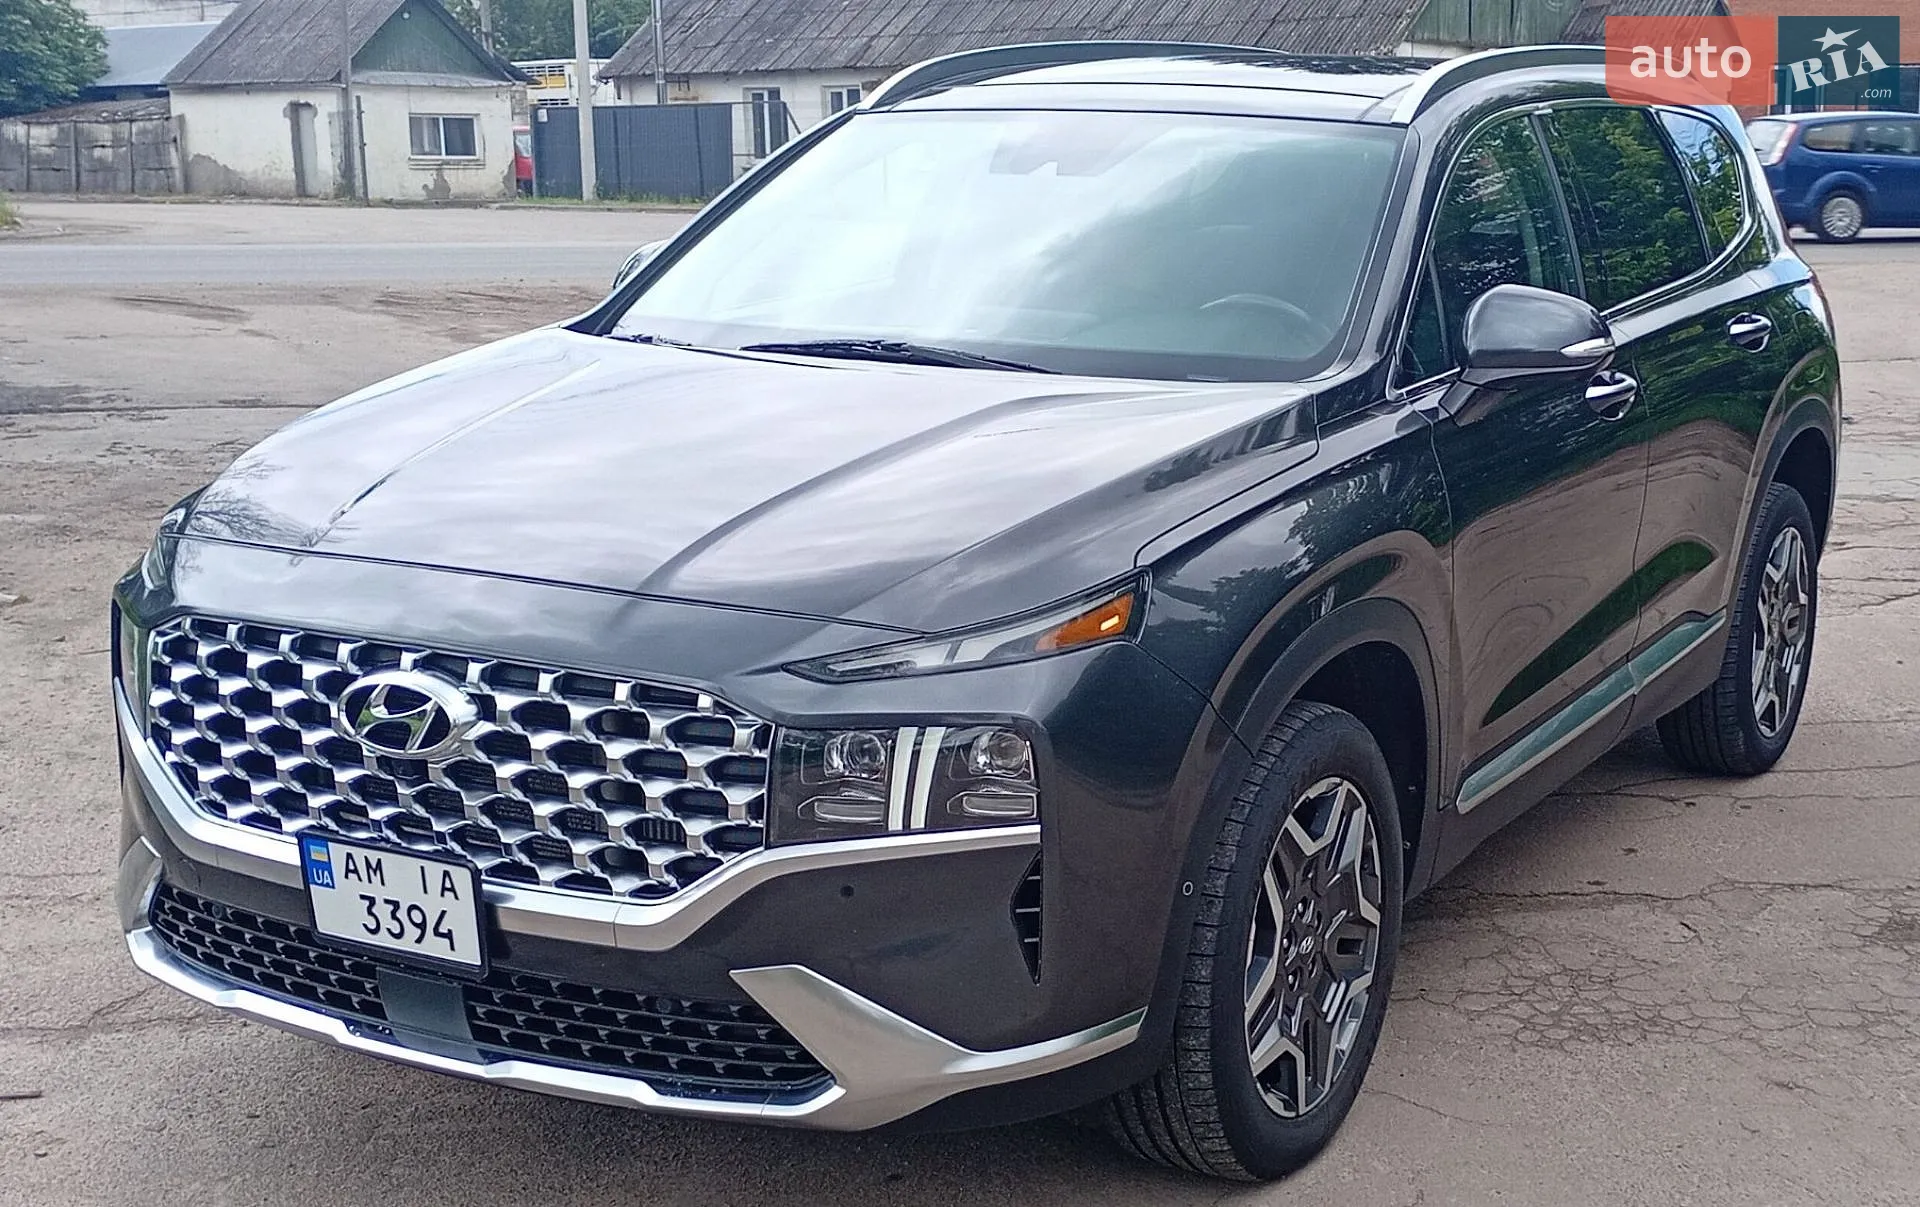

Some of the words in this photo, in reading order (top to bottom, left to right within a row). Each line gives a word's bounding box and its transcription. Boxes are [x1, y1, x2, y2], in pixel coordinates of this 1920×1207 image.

[312, 868, 332, 886] UA
[344, 851, 385, 886] AM
[420, 865, 459, 901] IA
[358, 893, 455, 952] 3394
